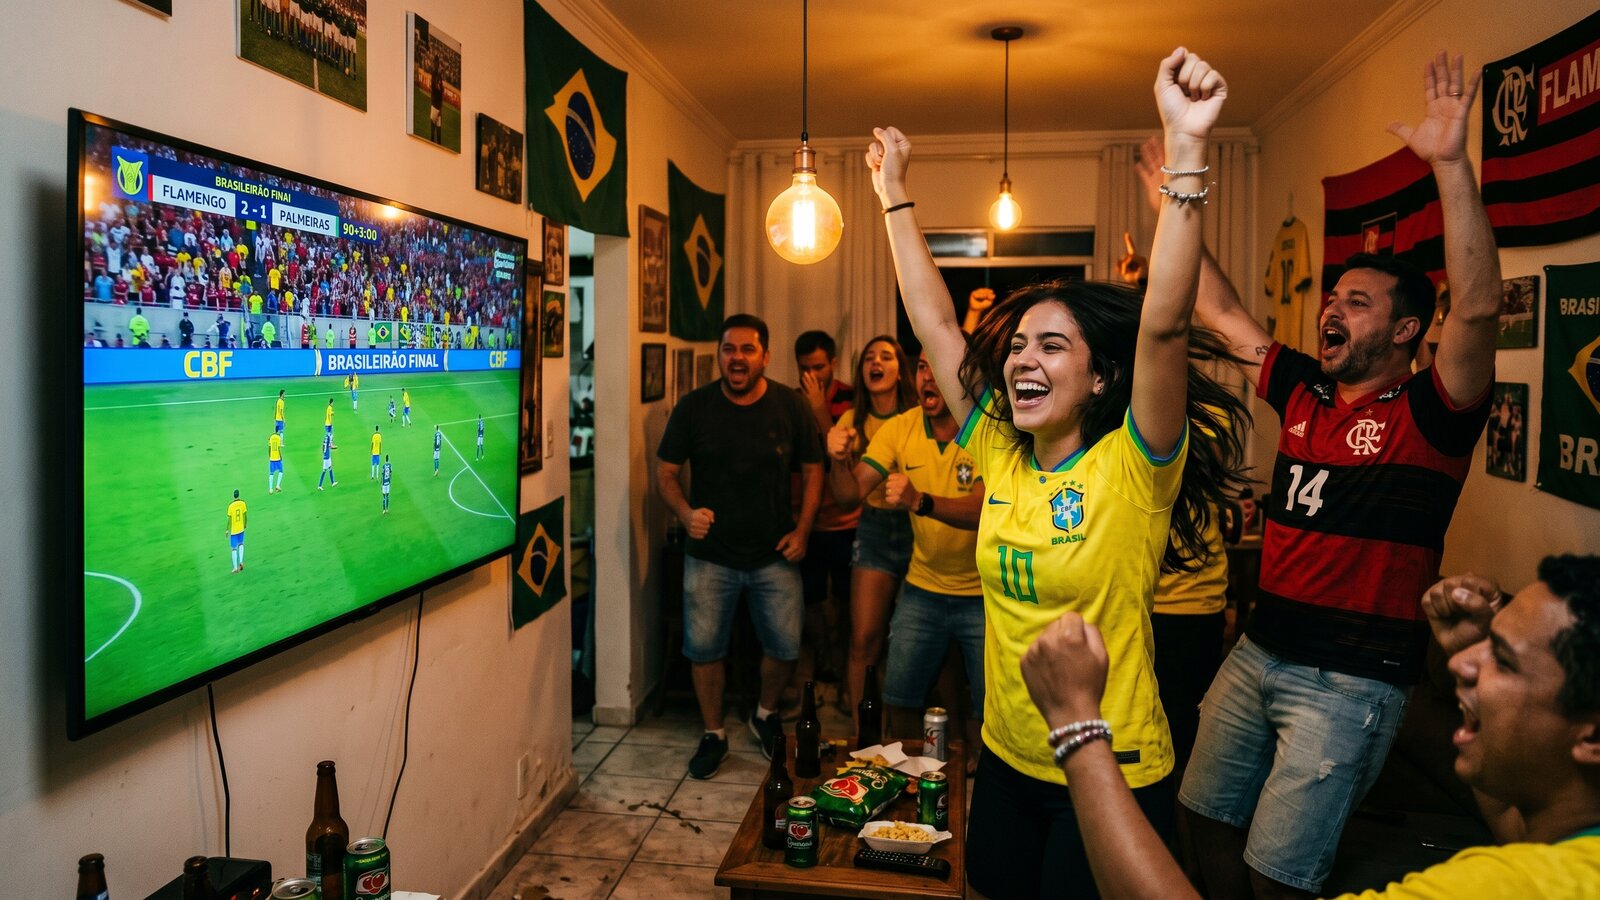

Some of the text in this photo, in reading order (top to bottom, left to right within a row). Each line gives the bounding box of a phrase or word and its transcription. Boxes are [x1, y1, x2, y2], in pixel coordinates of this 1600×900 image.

[163, 184, 227, 210] FLAMENGO
[215, 176, 270, 198] BRASILEIRÃO
[240, 200, 249, 215] 2
[260, 205, 267, 219] 1
[279, 210, 330, 231] PALMEIRAS
[343, 222, 377, 241] 90+3:00
[184, 350, 233, 378] CBF
[328, 351, 439, 370] BRASILEIRÃO FINAL
[489, 351, 508, 368] CBF
[1559, 433, 1600, 476] BR
[1285, 464, 1330, 517] 14
[1060, 504, 1073, 513] CBF
[1051, 533, 1087, 546] BRASIL
[998, 545, 1039, 605] 10
